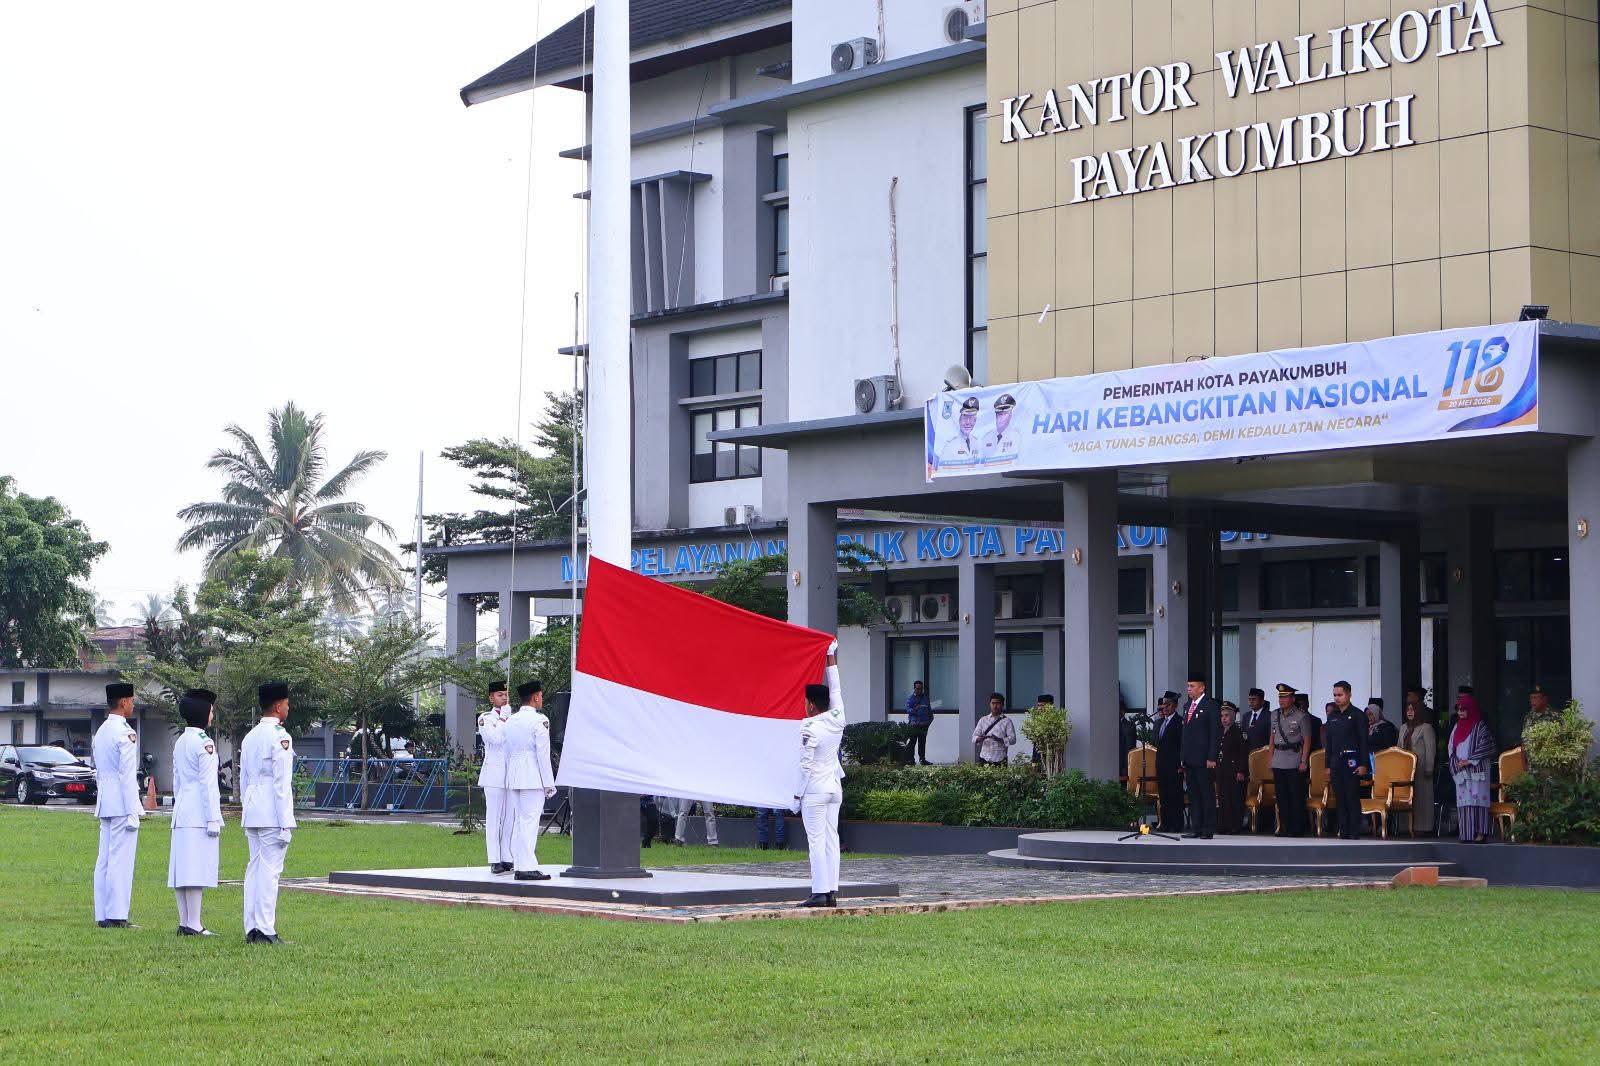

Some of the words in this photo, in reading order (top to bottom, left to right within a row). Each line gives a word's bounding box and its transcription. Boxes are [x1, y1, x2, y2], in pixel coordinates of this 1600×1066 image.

[1000, 61, 1196, 144] KANTOR
[1215, 0, 1502, 98] WALIKOTA
[1070, 94, 1416, 203] PAYAKUMBUH
[1103, 378, 1194, 400] PEMERINTAH
[1199, 374, 1235, 391] KOTA
[1238, 360, 1347, 386] PAYAKUMBUH
[1442, 336, 1510, 397] 118
[1031, 409, 1089, 434] HARI
[1097, 390, 1275, 430] KEBANGKITAN
[1286, 374, 1427, 411] NASIONAL
[1105, 436, 1145, 450] TUNAS
[1203, 427, 1235, 442] DEMI
[1237, 420, 1323, 440] KEDAULATAN
[916, 526, 1002, 560] KOTA
